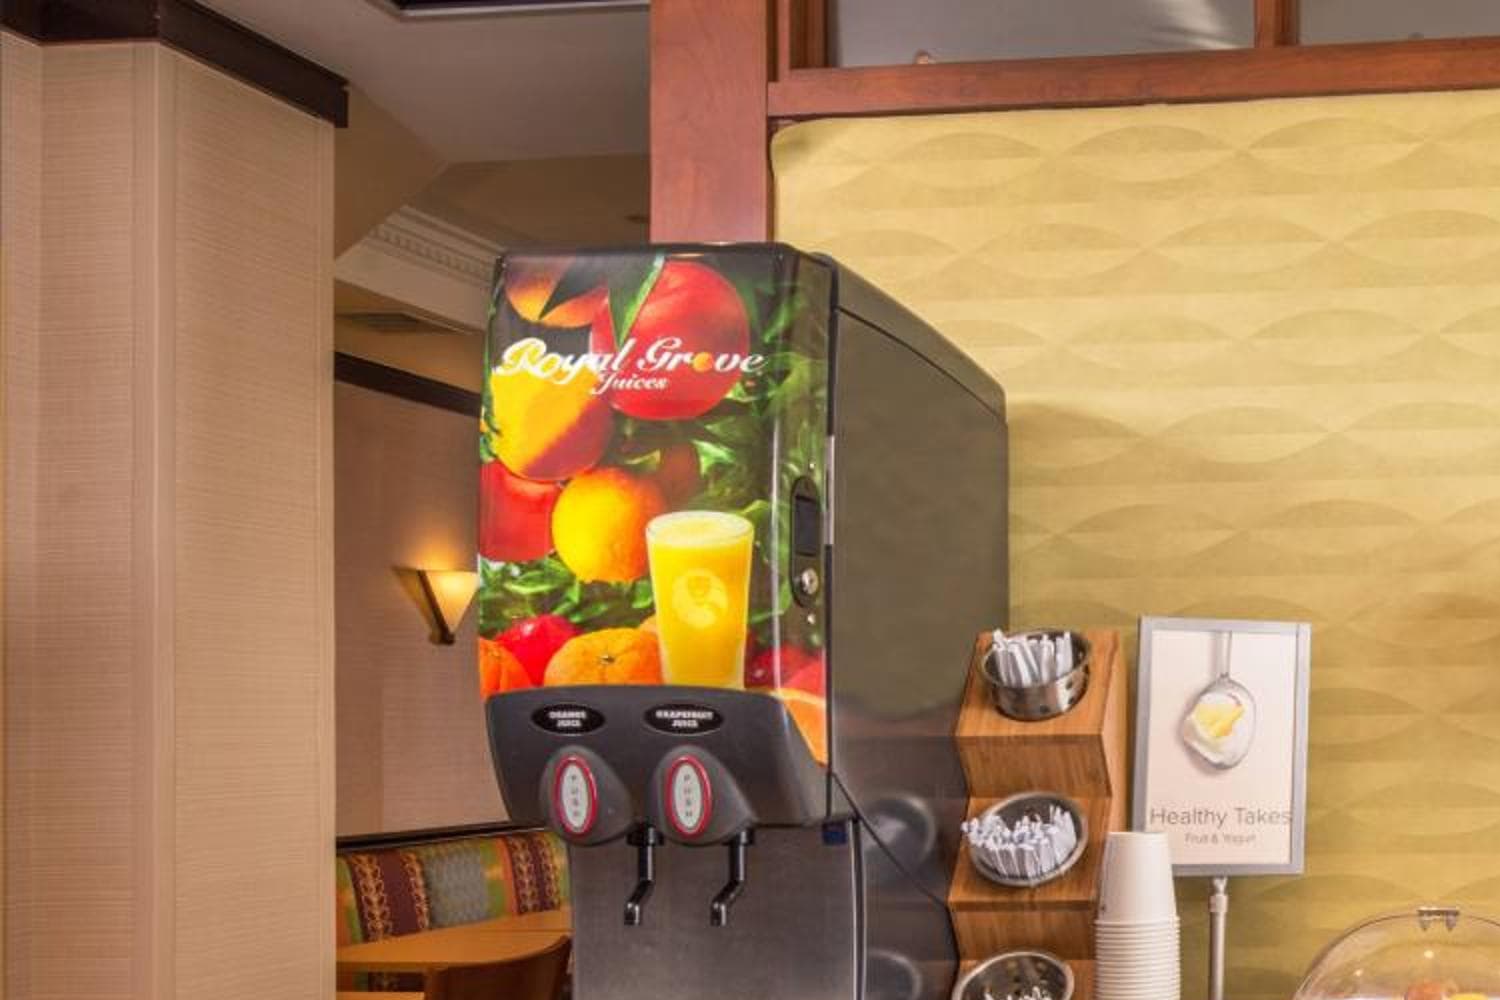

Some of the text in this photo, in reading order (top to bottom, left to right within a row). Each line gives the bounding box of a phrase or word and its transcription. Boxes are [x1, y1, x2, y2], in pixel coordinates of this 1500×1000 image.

[491, 336, 766, 386] Royal Grove
[590, 372, 669, 394] Juices
[549, 710, 587, 719] ORANGE
[655, 710, 714, 720] GRAPEFRUIT
[556, 719, 582, 728] JUICE
[671, 719, 699, 728] JUICE
[1151, 807, 1293, 829] Healthy Takes
[1184, 833, 1257, 846] Fruit & Yogurt
